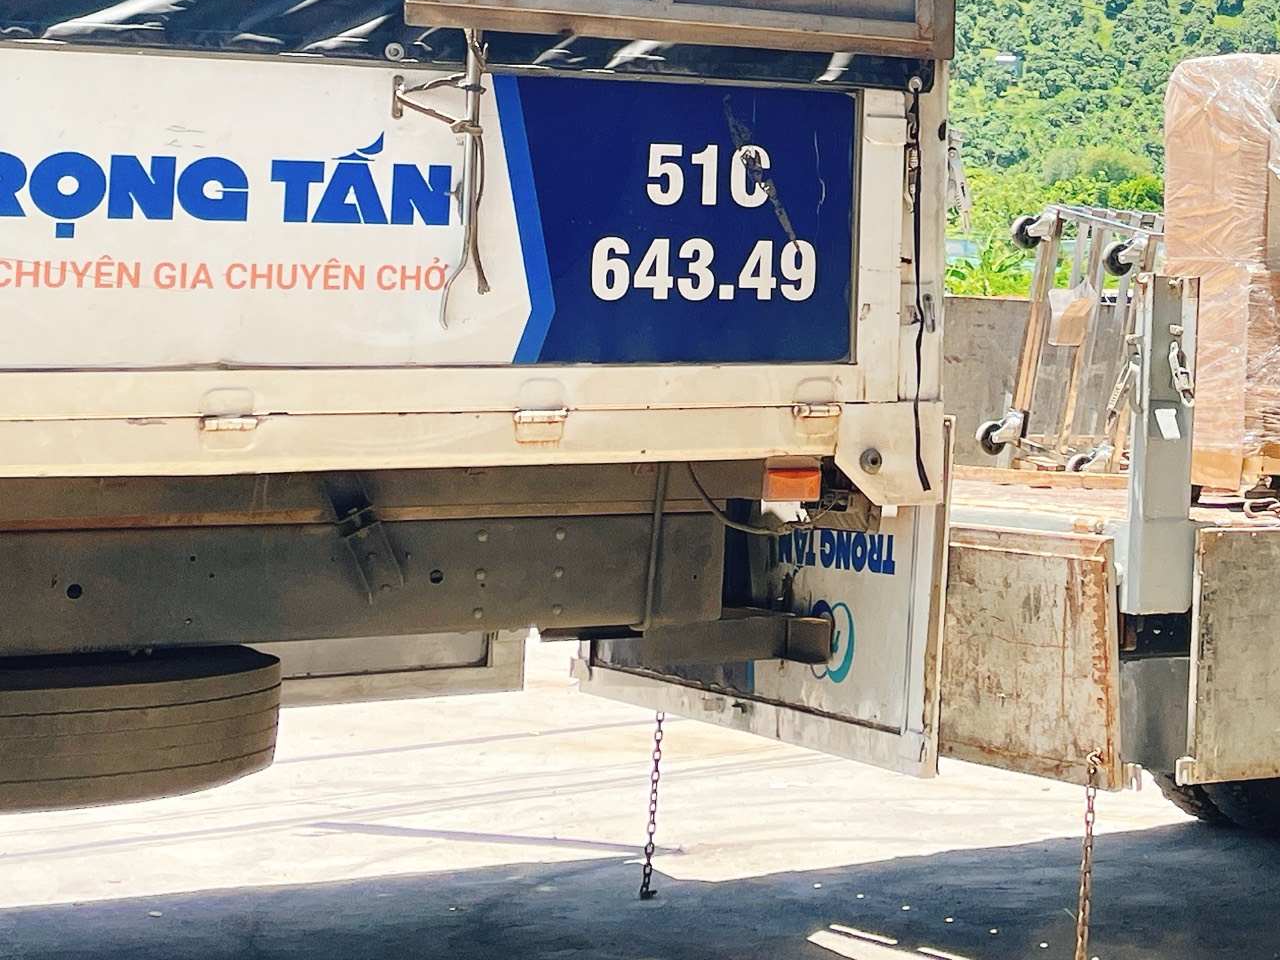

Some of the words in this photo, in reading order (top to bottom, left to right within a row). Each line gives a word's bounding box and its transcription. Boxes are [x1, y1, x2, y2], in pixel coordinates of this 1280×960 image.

[271, 131, 452, 226] TẤN
[646, 143, 771, 208] 51C
[153, 261, 214, 290] GIA
[225, 257, 366, 291] CHUYÊN
[376, 256, 449, 291] CHỞ
[591, 236, 817, 302] 643.49
